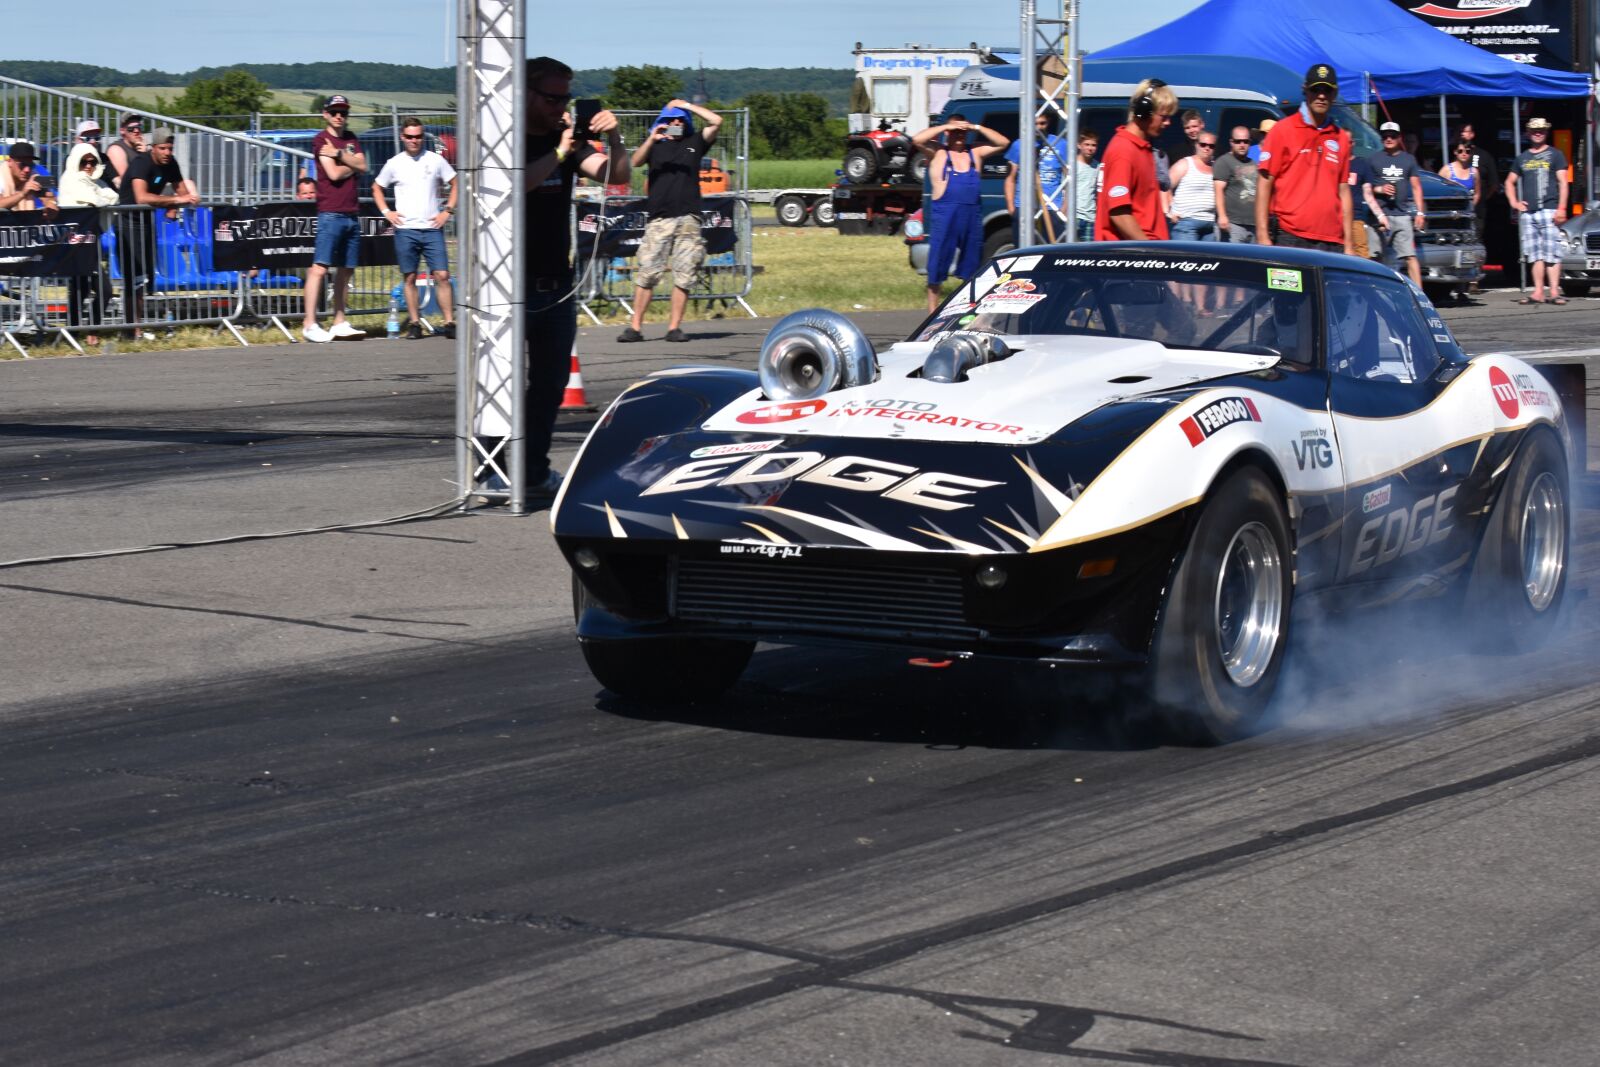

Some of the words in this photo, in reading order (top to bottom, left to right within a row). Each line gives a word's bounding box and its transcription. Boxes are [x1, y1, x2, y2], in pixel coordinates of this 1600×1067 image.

[1053, 258, 1220, 272] www.corvette.vtg.pl
[828, 408, 1023, 435] INTEGRATOR
[1197, 399, 1248, 433] FERODO
[1319, 428, 1327, 437] by
[710, 442, 774, 455] Castrol
[1291, 438, 1333, 470] VTG
[639, 451, 1008, 511] EDGE
[1346, 483, 1461, 578] EDGE
